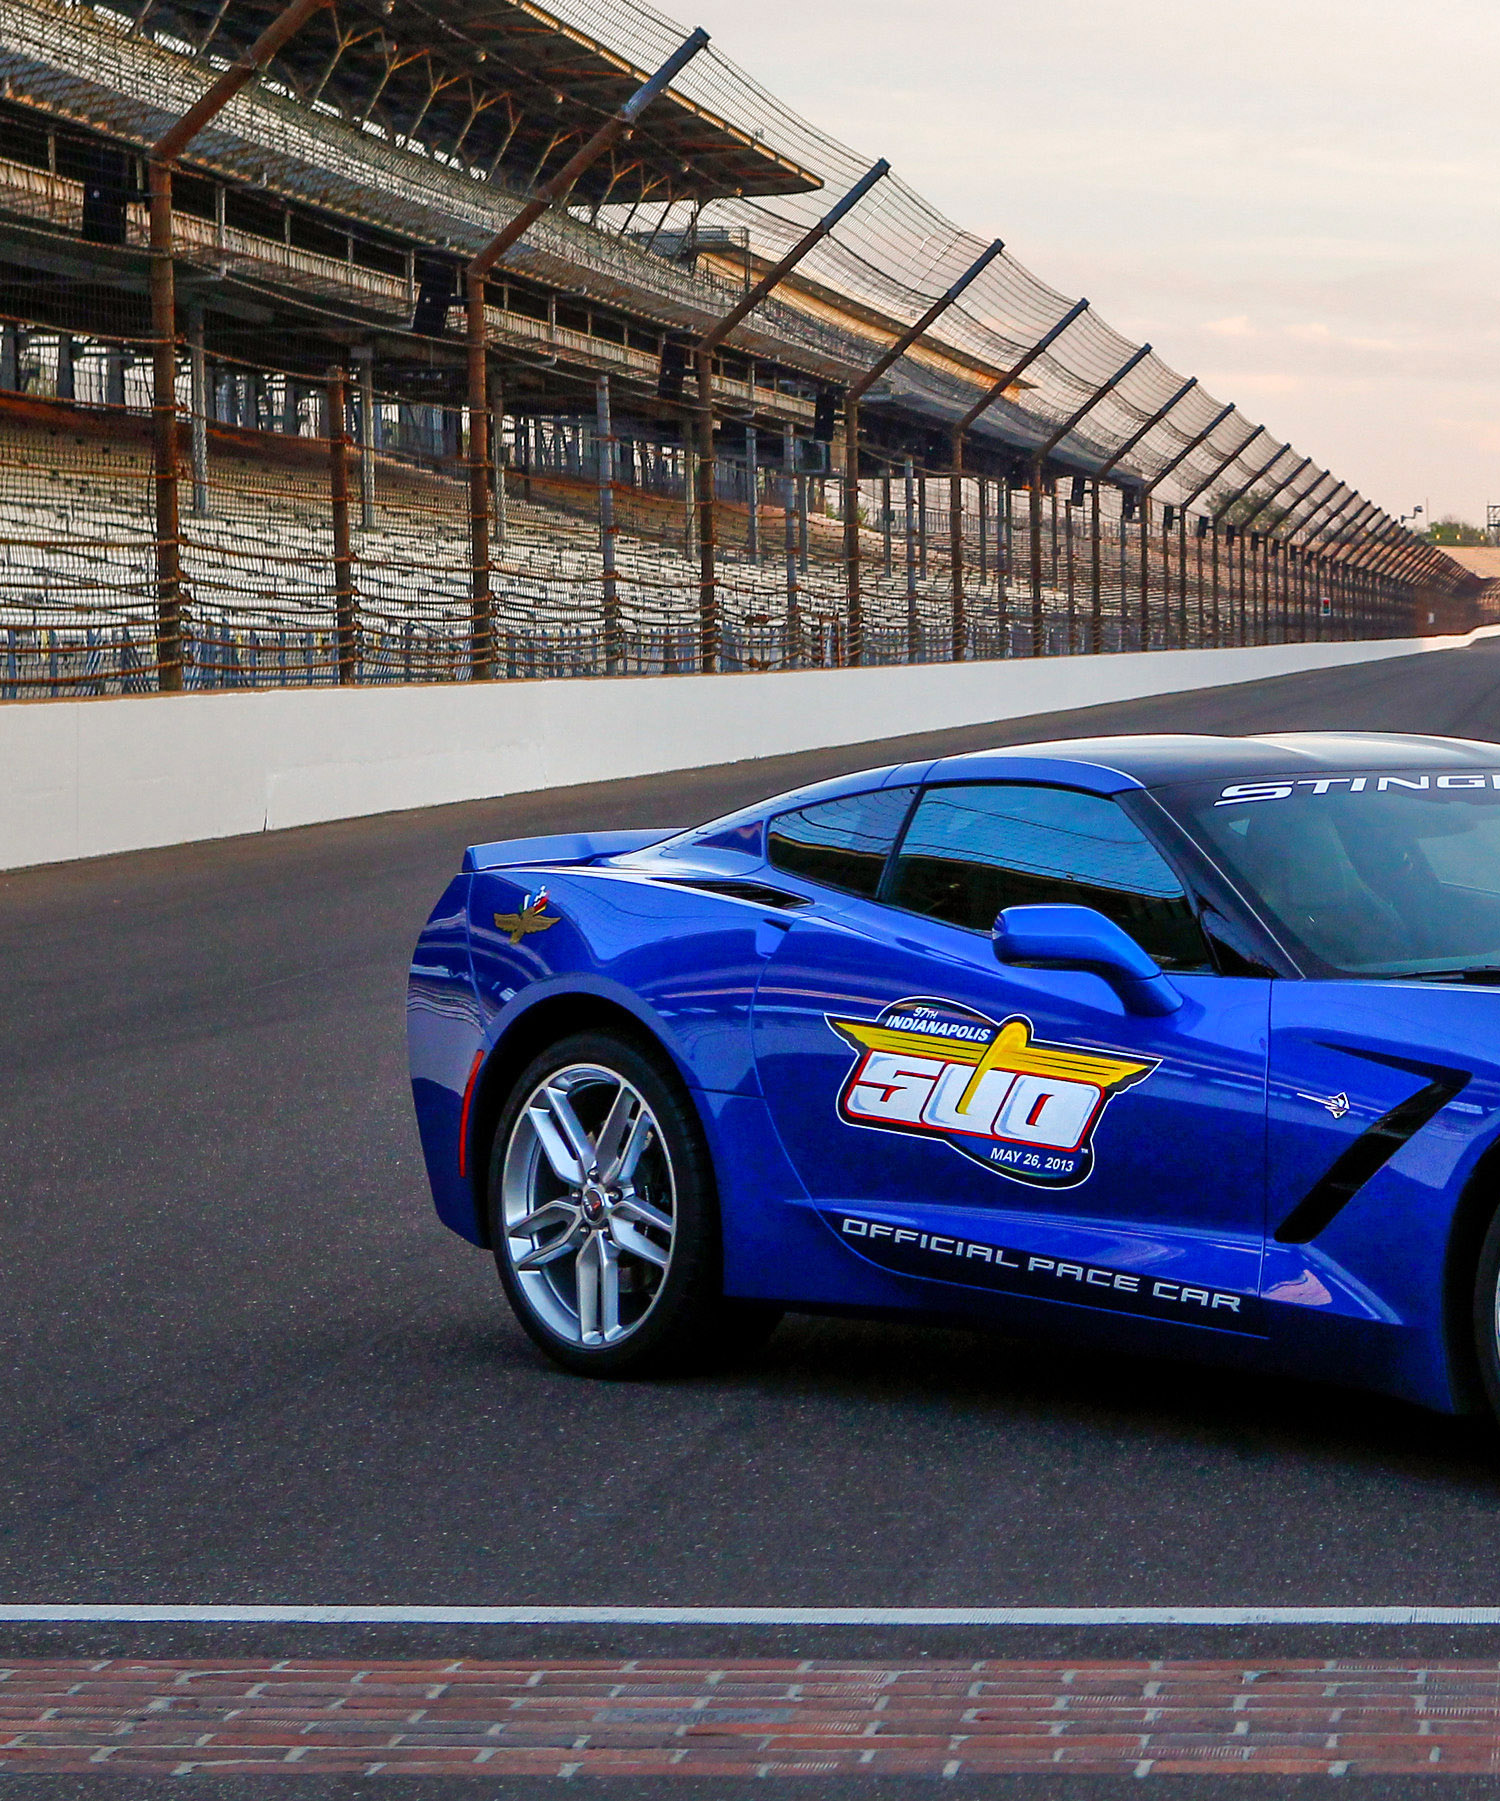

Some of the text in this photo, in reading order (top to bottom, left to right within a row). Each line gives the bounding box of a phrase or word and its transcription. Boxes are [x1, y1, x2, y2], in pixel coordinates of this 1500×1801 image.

[913, 1006, 939, 1019] 97TH
[885, 1015, 991, 1041] INDIANAPOLIS
[846, 1050, 1102, 1149] 500
[990, 1147, 1075, 1172] MAY 26, 2013
[842, 1218, 1241, 1313] OFFICIAL PACE CAR
